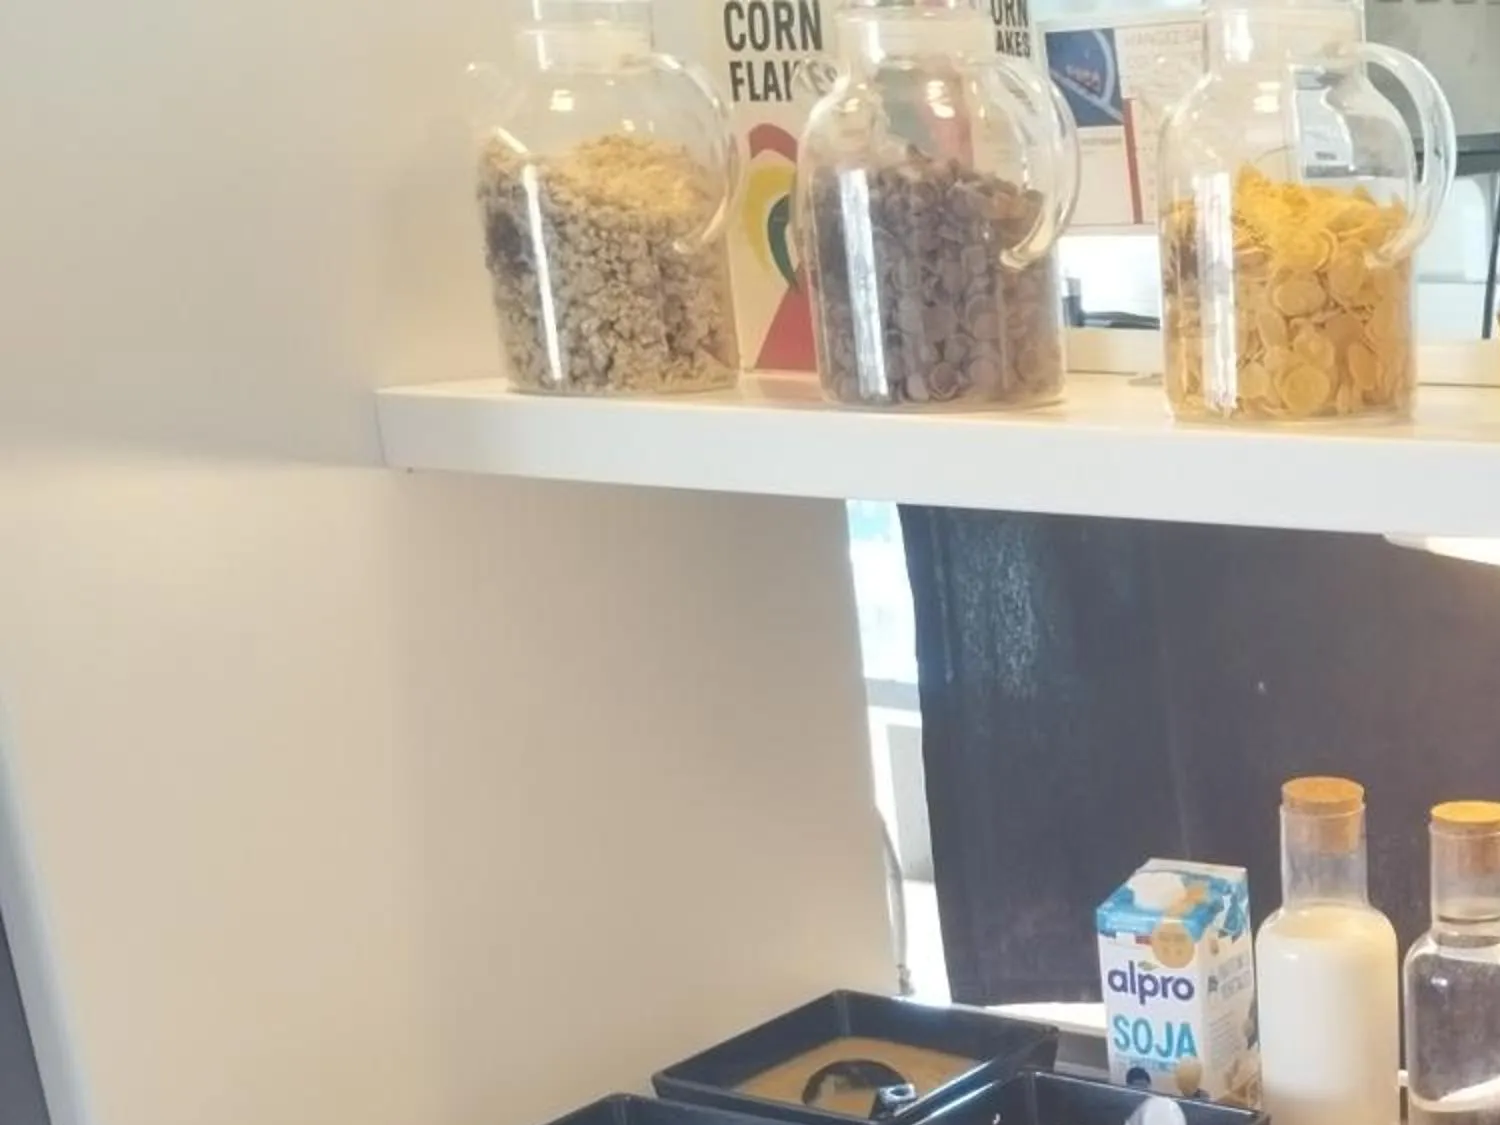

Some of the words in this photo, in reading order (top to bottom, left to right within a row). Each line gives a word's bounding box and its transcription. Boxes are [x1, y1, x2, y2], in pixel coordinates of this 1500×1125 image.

[723, 0, 823, 52] CORN
[1107, 960, 1196, 1004] alpro
[1112, 1013, 1198, 1059] SOJA
